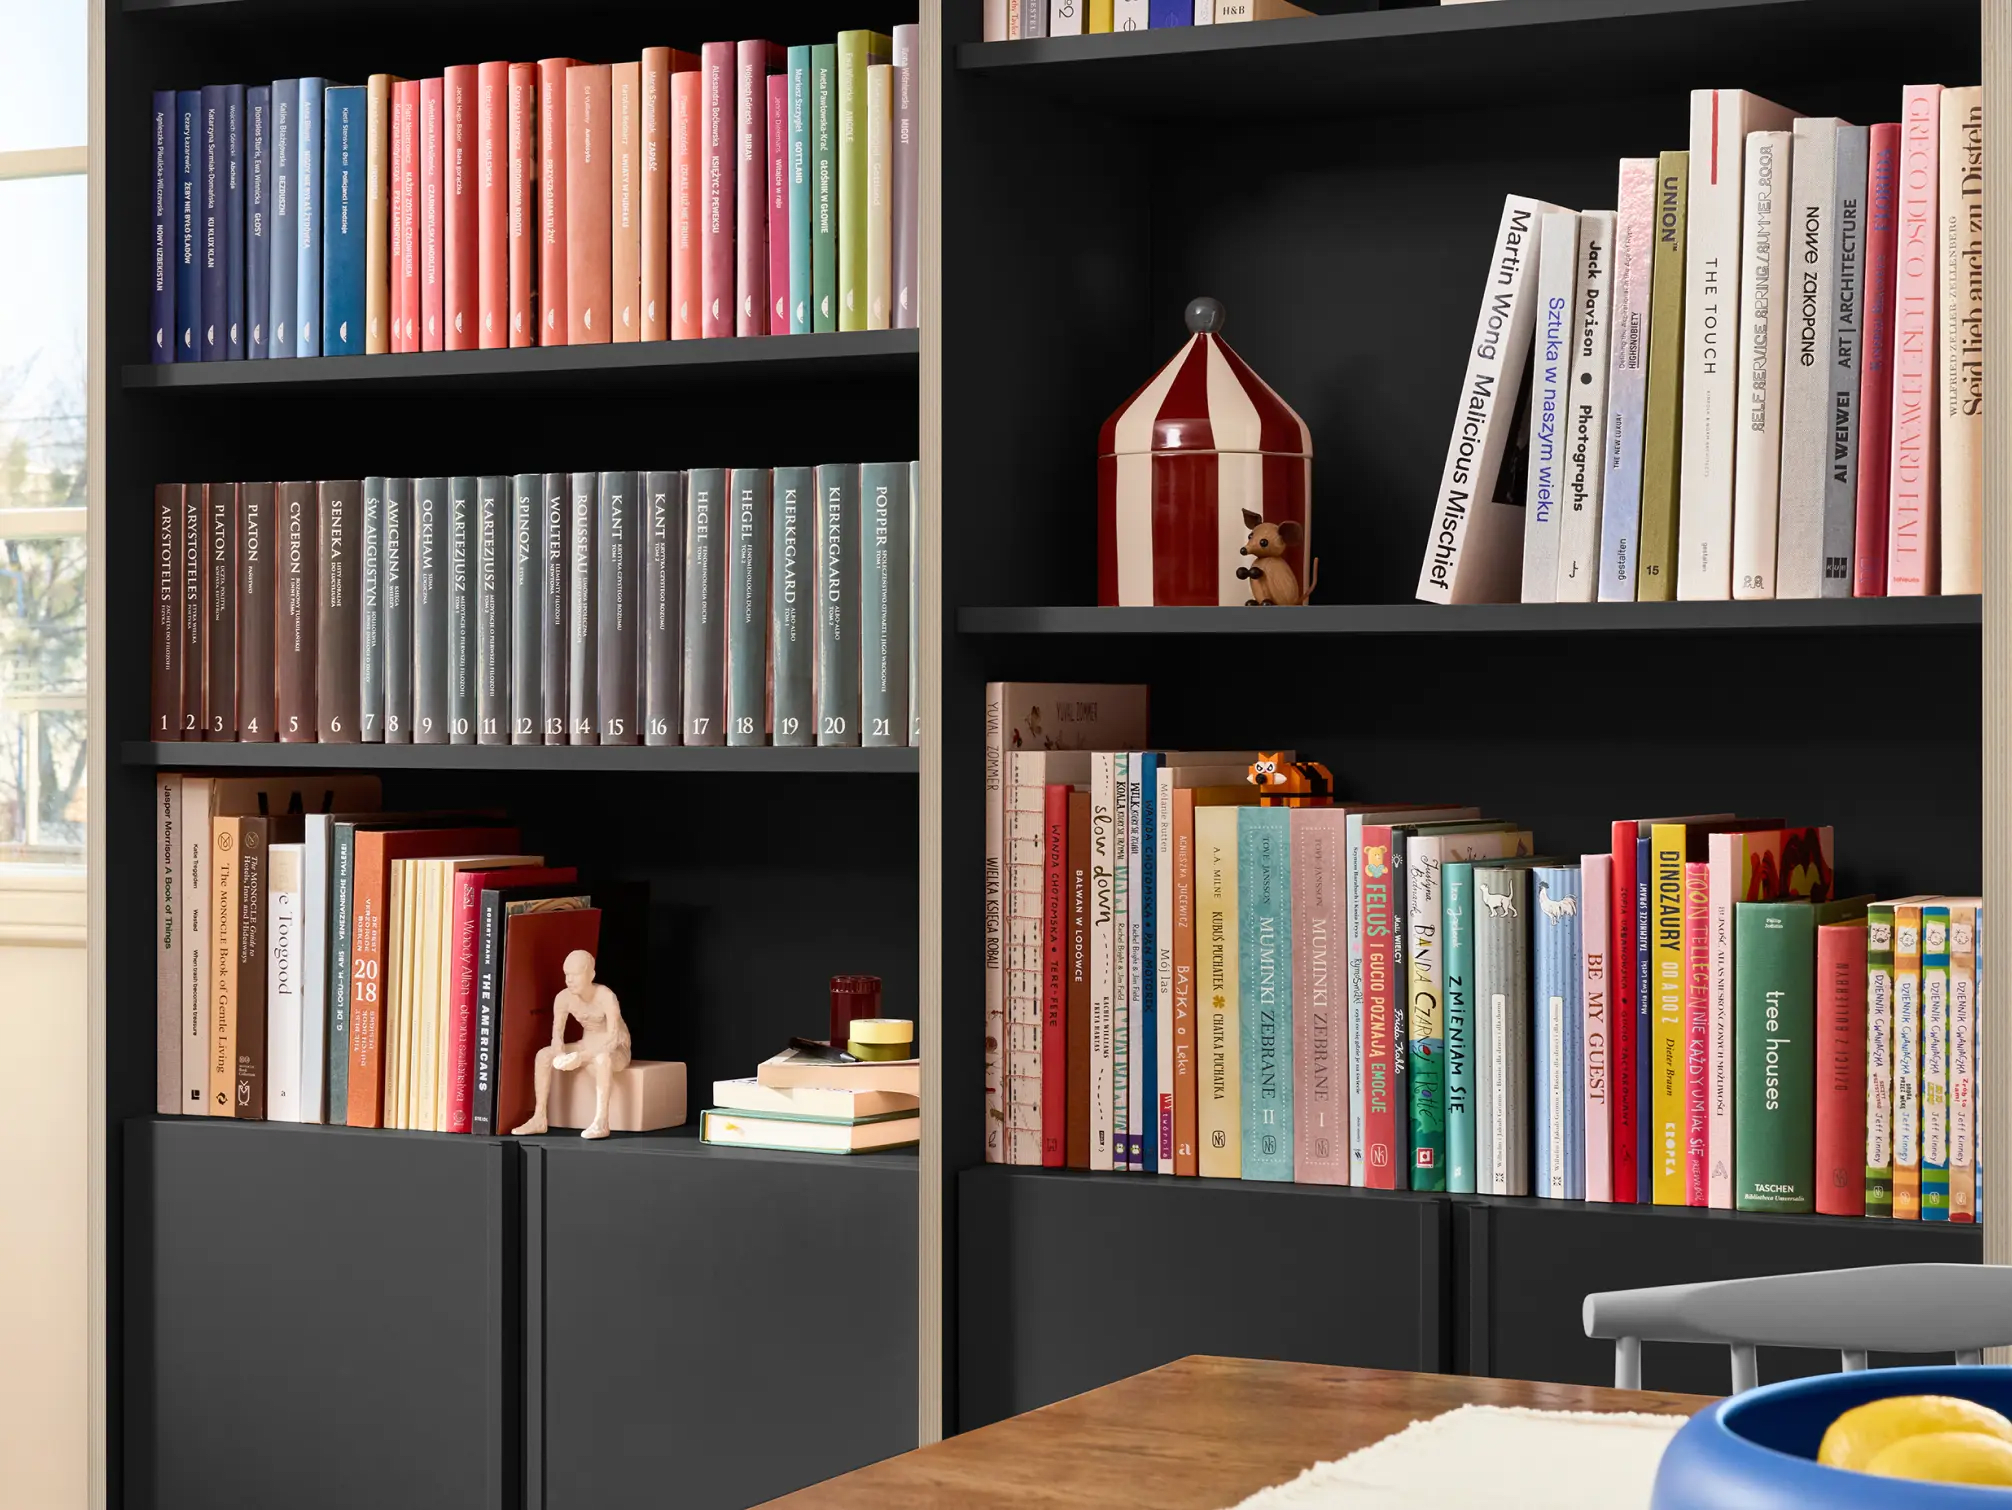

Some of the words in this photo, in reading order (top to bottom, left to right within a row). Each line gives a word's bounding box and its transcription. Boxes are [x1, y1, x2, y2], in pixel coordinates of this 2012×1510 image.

[1223, 5, 1245, 15] H&B
[820, 68, 828, 89] Aneta
[183, 113, 191, 135] Cezary
[820, 91, 828, 151] Pawłowska-Krać
[1909, 98, 1930, 189] GRECO
[1962, 106, 1982, 199] Disteln
[156, 147, 164, 216] Pikulicka-Wilczewska
[710, 156, 720, 188] KSIĘŻYC
[820, 160, 829, 193] GŁOŚNIK
[208, 217, 214, 226] KU
[1907, 200, 1927, 277] DISCO
[1499, 210, 1531, 285] Martin
[1587, 241, 1602, 279] Jack
[1842, 200, 1856, 323] ARCHITECTURE
[1705, 258, 1718, 295] THE
[1478, 293, 1513, 360] Wong
[1546, 297, 1564, 361] Sztuka
[1583, 290, 1600, 356] Davison
[1629, 312, 1639, 369] HIGHSNOBIETY
[1704, 305, 1717, 374] TOUCH
[1839, 337, 1852, 368] ART
[1545, 367, 1560, 383] w
[1454, 374, 1494, 483] Malicious
[1539, 389, 1557, 461] naszym
[1834, 392, 1849, 460] WEIWEI
[1899, 374, 1922, 482] EDWARD
[1572, 405, 1592, 511] Photographs
[1834, 466, 1847, 483] AI
[1536, 467, 1554, 522] wieku
[248, 505, 258, 561] PLATON
[332, 501, 341, 558] SENEKA
[422, 500, 432, 568] OCKHAM
[612, 495, 622, 539] KANT
[741, 490, 752, 540] HEGEL
[876, 486, 887, 546] POPPER
[1897, 494, 1918, 562] HALL
[162, 506, 171, 600] ARYSTOTELES
[389, 500, 398, 581] AWICENNA
[454, 500, 465, 591] KARTEZJUSZ
[829, 487, 839, 601] KIERKEGAARD
[1430, 490, 1468, 589] Mischief
[1618, 539, 1628, 580] gestalten
[1647, 566, 1659, 575] 15
[161, 717, 167, 729] 1
[248, 718, 258, 732] 4
[332, 716, 341, 731] 6
[390, 716, 398, 731] 8
[423, 718, 432, 733] 9
[451, 719, 468, 734] 10
[608, 719, 624, 734] 15
[737, 718, 753, 733] 18
[825, 717, 845, 733] 20
[873, 719, 890, 735] 21
[988, 702, 999, 737] YUVAL
[987, 746, 999, 791] ZOMMER
[163, 785, 173, 818] Jasper
[1161, 784, 1169, 819] Mélanie
[164, 821, 173, 864] Morrison
[1093, 806, 1110, 856] slow
[220, 863, 231, 887] The
[1213, 847, 1221, 865] A.A.
[165, 877, 173, 901] Book
[986, 858, 999, 896] WIELKA
[1075, 870, 1083, 913] BAŁWAN
[1094, 866, 1112, 927] down
[1213, 870, 1221, 898] MILNE
[165, 905, 173, 915] of
[250, 873, 258, 923] MONOCLE
[986, 900, 998, 934] KSIĘGA
[1367, 884, 1389, 936] FELUŚ
[1659, 851, 1680, 951] DINOZAURY
[164, 918, 173, 949] Things
[1075, 917, 1083, 926] W
[1212, 912, 1225, 941] KUBUŚ
[275, 913, 292, 994] Toogood
[460, 920, 474, 963] Woody
[987, 938, 999, 969] ROBALI
[1075, 930, 1084, 982] LODÓWCE
[1158, 948, 1171, 972] Mój
[1260, 917, 1274, 1004] MUMINKI
[219, 948, 228, 977] Book
[354, 960, 377, 979] 20
[460, 967, 472, 995] Allen
[1212, 945, 1223, 990] PUCHATEK
[1312, 918, 1327, 1006] MUMINKI
[1371, 953, 1385, 991] GUCIO
[1588, 953, 1603, 979] BE
[218, 980, 228, 991] of
[356, 983, 377, 1002] 18
[481, 974, 491, 999] THE
[1161, 975, 1170, 993] las
[1956, 982, 1967, 1021] DZIENNIK
[218, 995, 228, 1032] Gentle
[458, 1005, 469, 1042] obrona
[1369, 997, 1385, 1057] POZNAJĄ
[1588, 992, 1603, 1023] MY
[1766, 991, 1784, 1031] tree
[479, 1005, 490, 1091] AMERICANS
[1213, 1014, 1224, 1049] CHATKA
[1956, 1026, 1967, 1074] CWANIACZKA
[217, 1037, 228, 1073] Living
[1261, 1011, 1275, 1099] ZEBRANE
[1314, 1013, 1328, 1101] ZEBRANE
[1589, 1033, 1604, 1104] GUEST
[1666, 1038, 1675, 1067] Dieter
[456, 1045, 469, 1101] szaleństwa
[1213, 1053, 1224, 1099] PUCHATKA
[1372, 1063, 1386, 1112] EMOCJE
[1666, 1069, 1674, 1096] Braun
[1766, 1040, 1790, 1110] houses
[1957, 1112, 1965, 1132] Jeff
[1956, 1135, 1965, 1162] Kinney
[1755, 1184, 1793, 1192] TASCHEN
